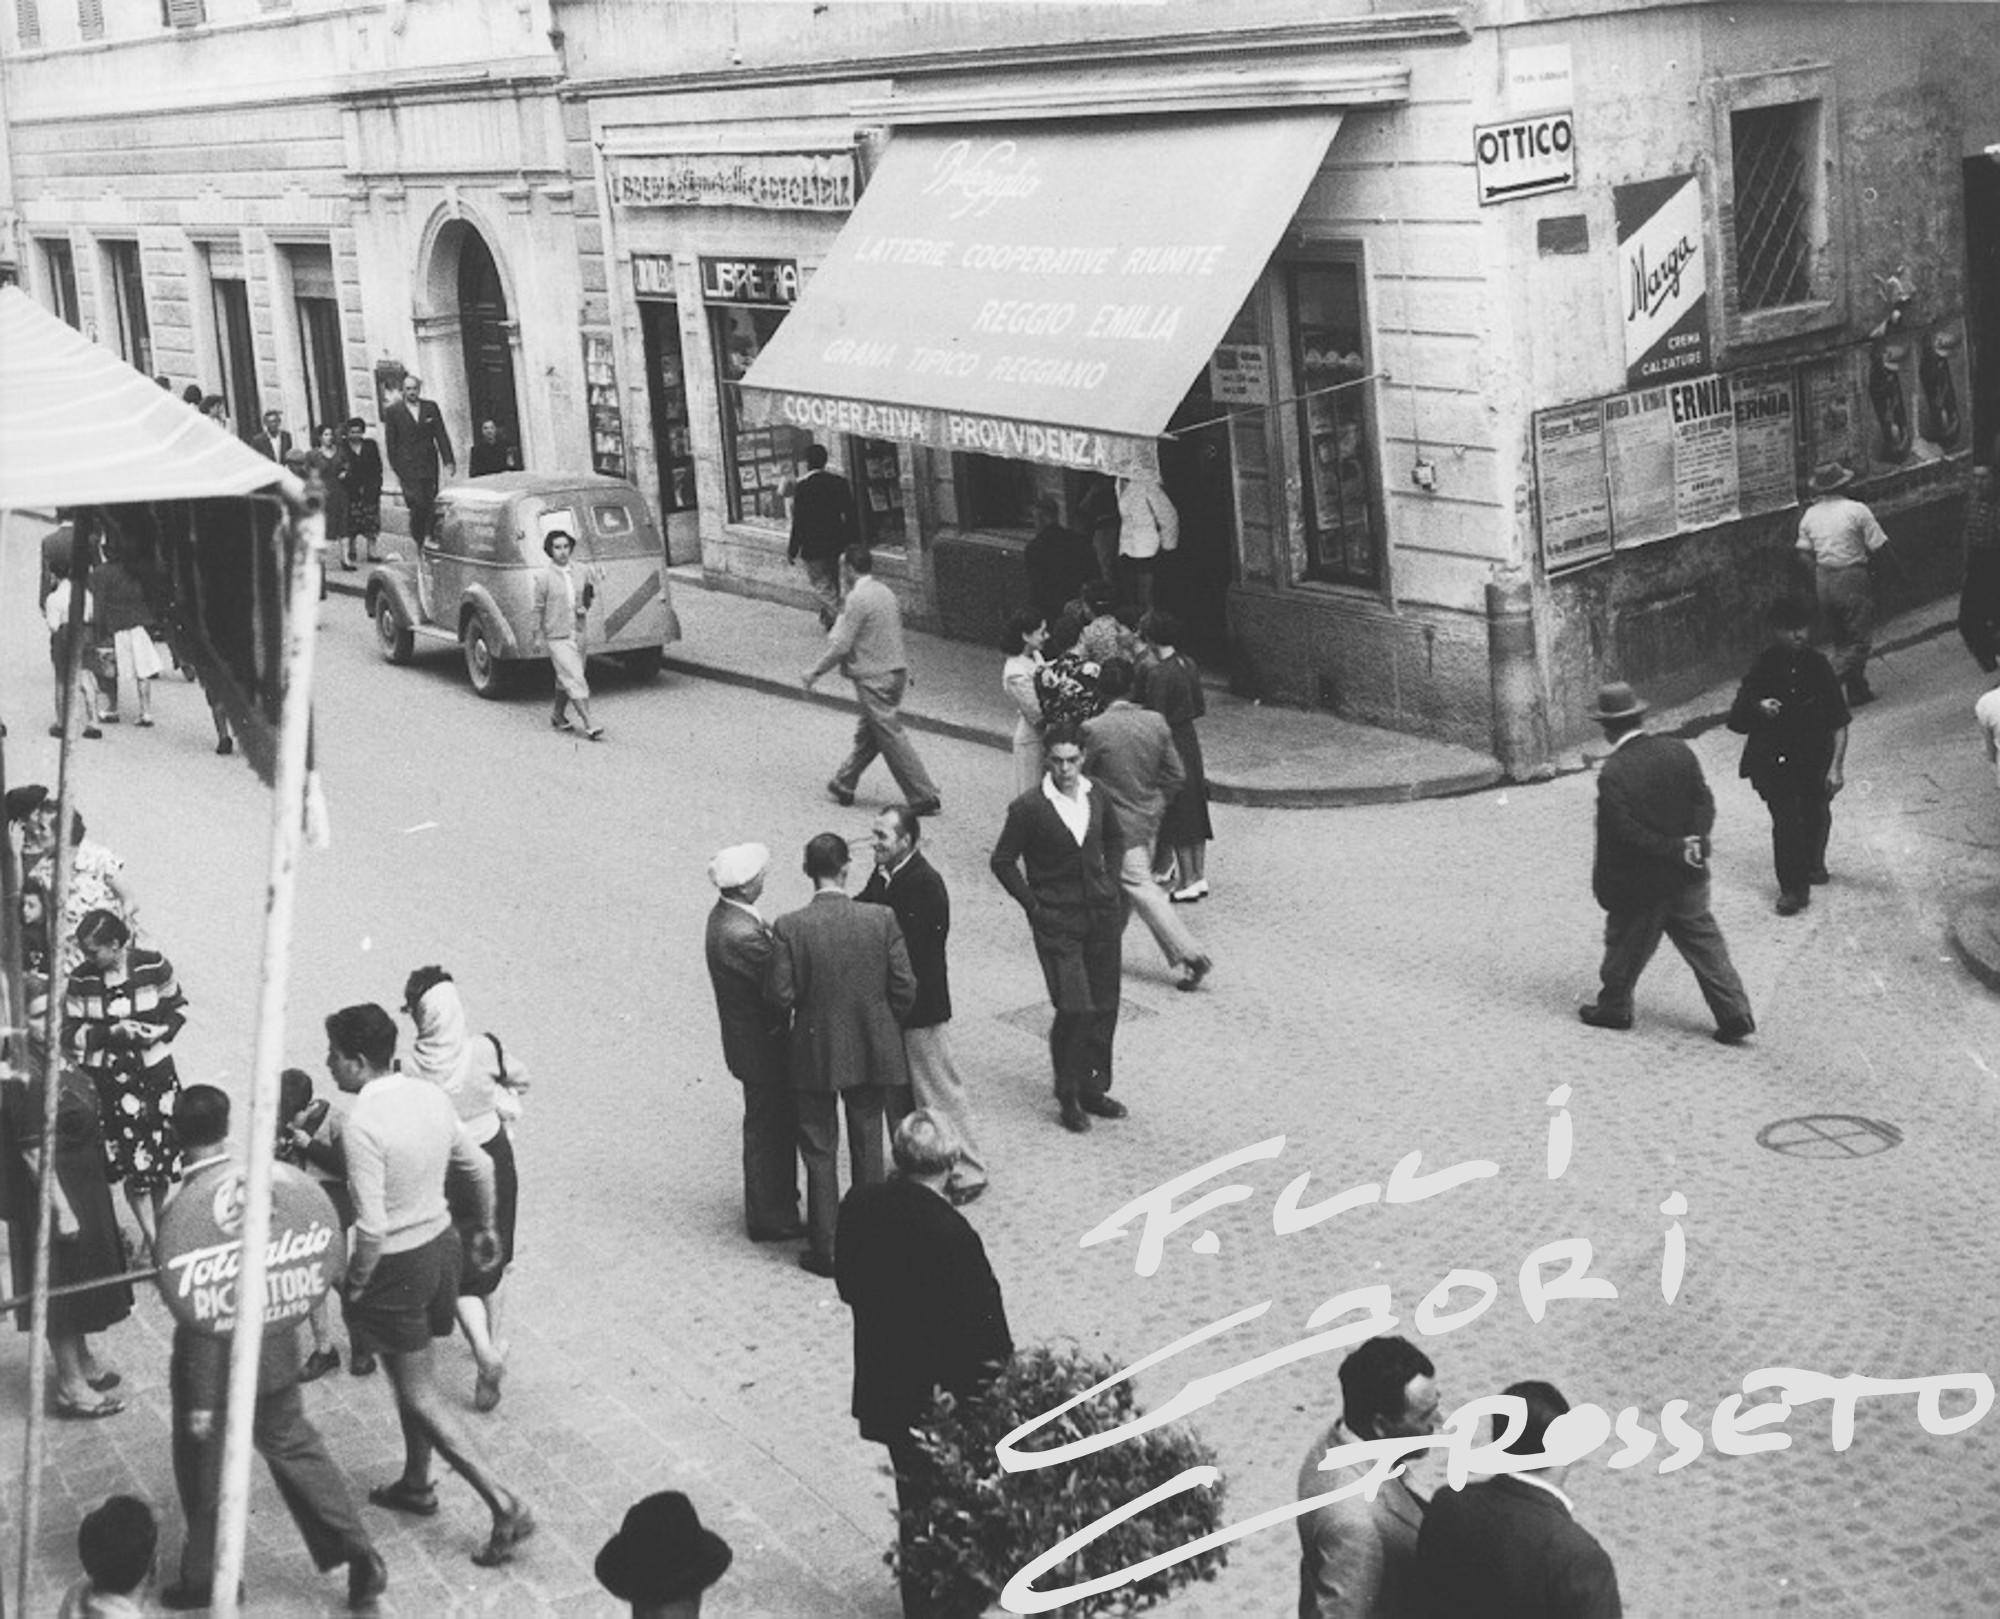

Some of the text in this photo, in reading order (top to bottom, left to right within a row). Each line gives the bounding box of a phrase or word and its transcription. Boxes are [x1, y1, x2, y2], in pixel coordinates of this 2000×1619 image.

[1477, 120, 1571, 164] OTTICO
[854, 236, 1227, 275] LATTERIE COOPERATIVE RIUNITE
[1627, 235, 1699, 321] Marga
[972, 300, 1184, 342] REGGIO EMILIA
[822, 339, 1109, 390] GRANA TIPICO REGGIANO
[1641, 350, 1702, 376] CALZATURE
[1670, 378, 1733, 424] ERNIA
[1733, 391, 1792, 426] ERNIA
[784, 395, 1108, 467] COOPERATIVA PROVVIDENZA
[168, 1220, 333, 1298] Totoalcio
[193, 1262, 326, 1321] RICTORE
